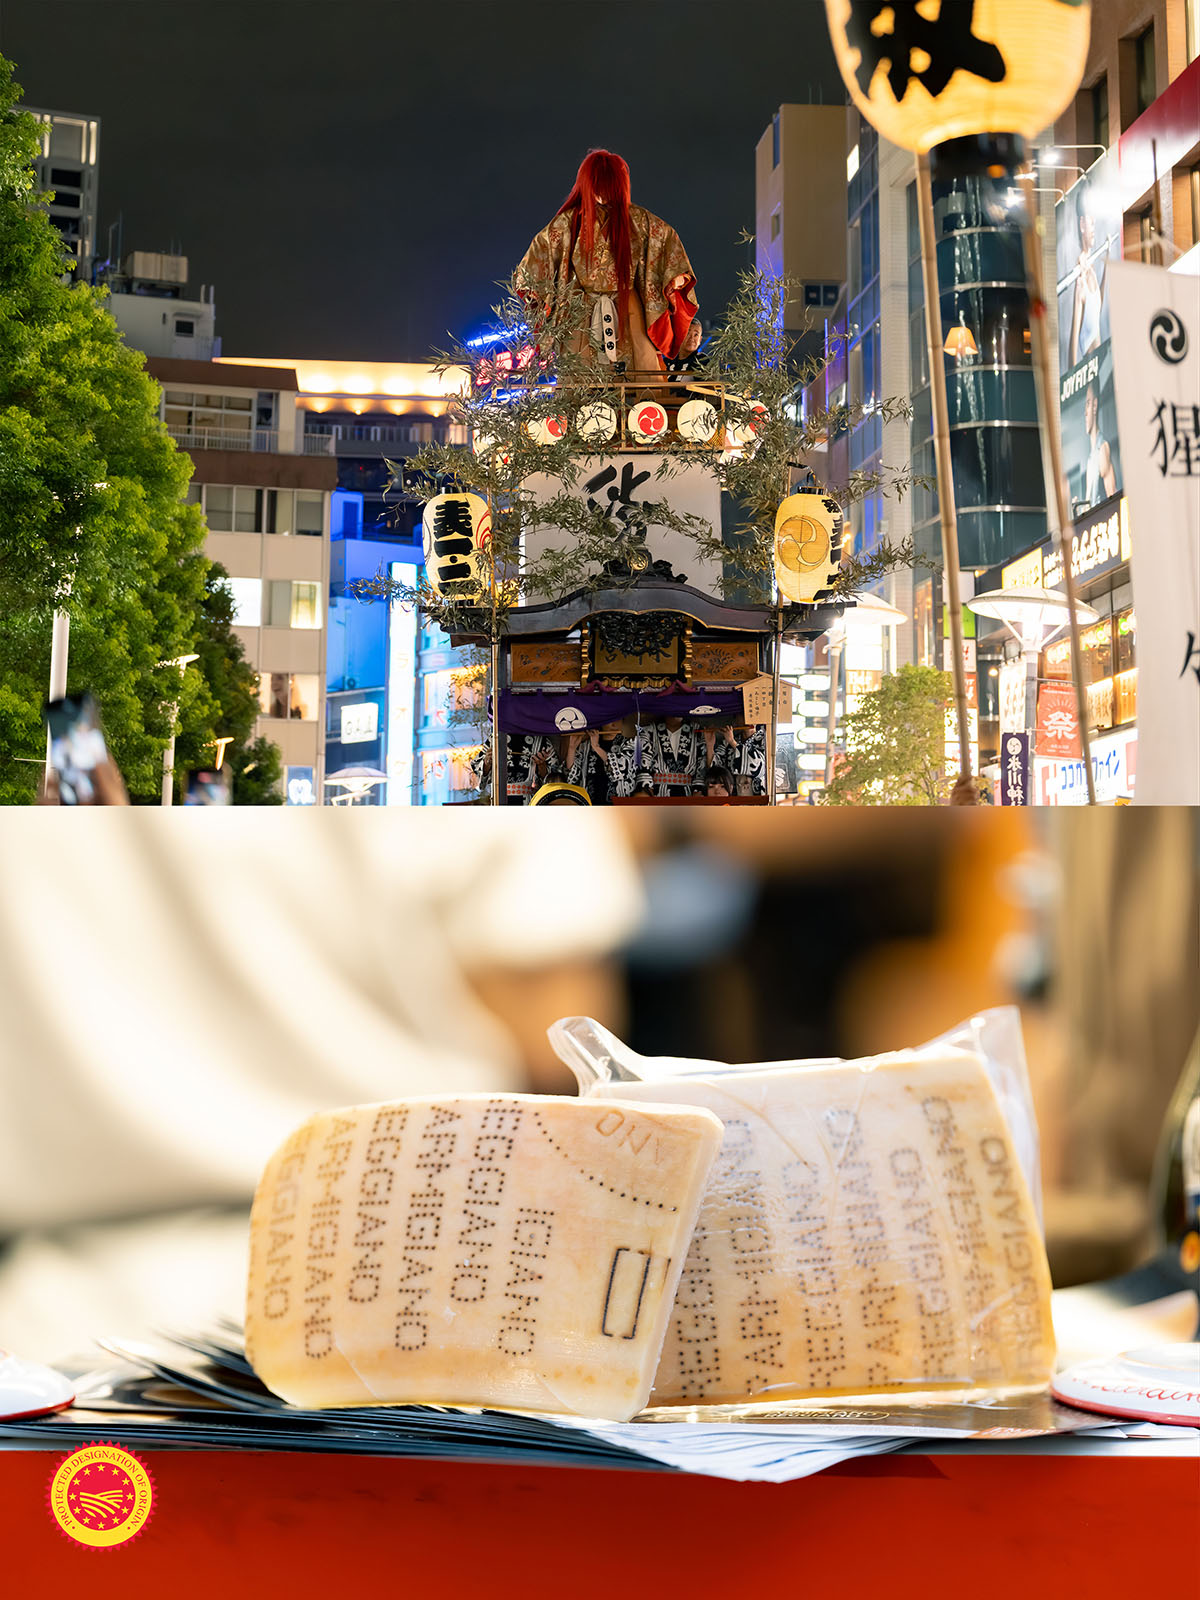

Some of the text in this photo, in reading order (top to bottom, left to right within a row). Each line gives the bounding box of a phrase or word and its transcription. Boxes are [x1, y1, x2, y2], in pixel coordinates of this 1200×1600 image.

[1042, 711, 1079, 740] 祭
[1006, 755, 1025, 805] 氷川神
[1061, 749, 1120, 790] ココカファイン
[781, 1160, 847, 1388] REGGIANO
[890, 1146, 958, 1382] REGGIANO
